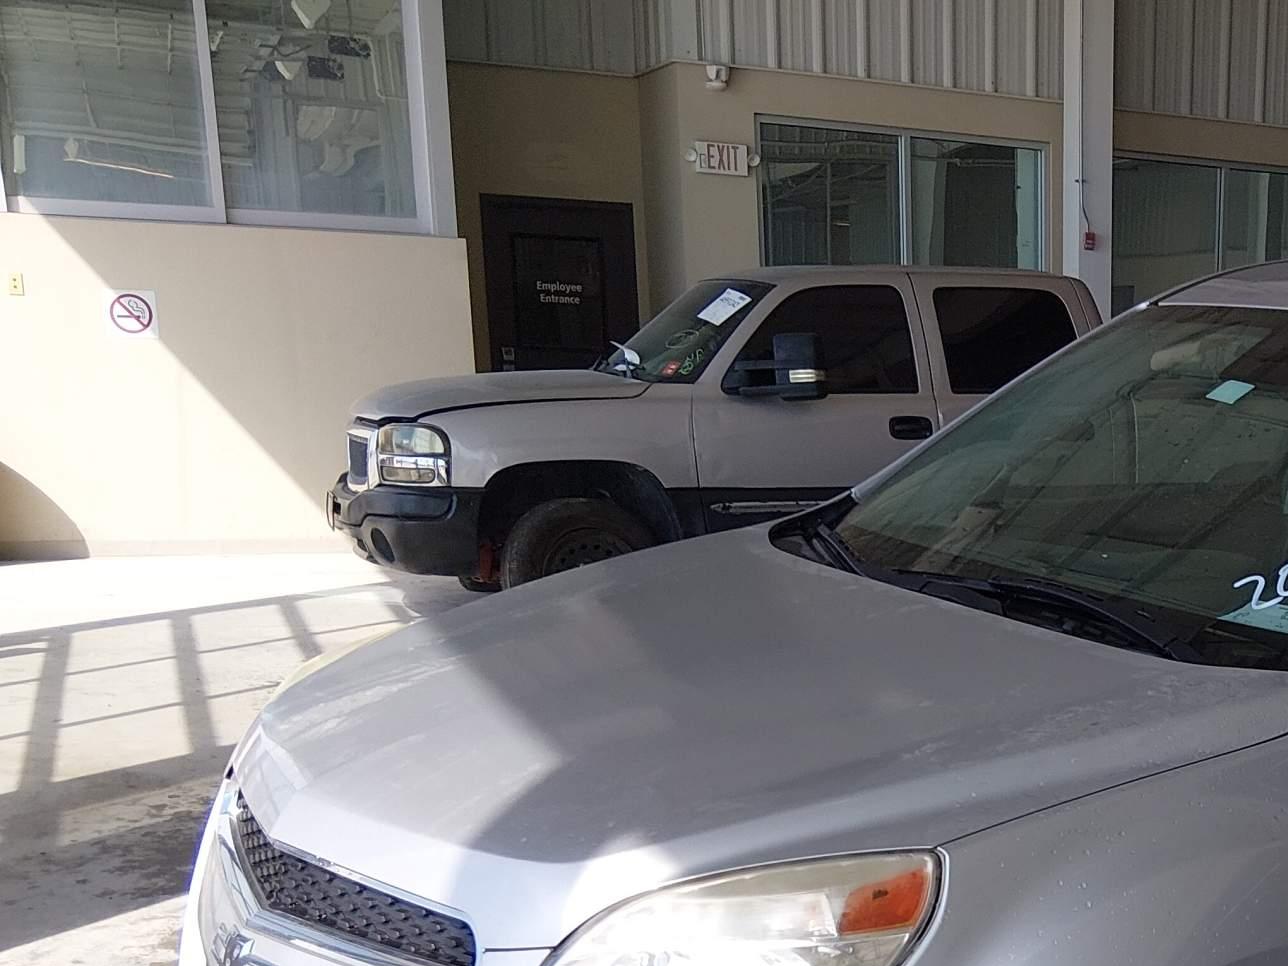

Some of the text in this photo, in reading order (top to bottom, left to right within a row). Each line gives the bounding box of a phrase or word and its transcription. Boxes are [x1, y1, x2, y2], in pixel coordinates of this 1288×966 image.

[706, 143, 740, 171] EXIT
[536, 280, 583, 294] Employee
[540, 293, 581, 305] Entrance
